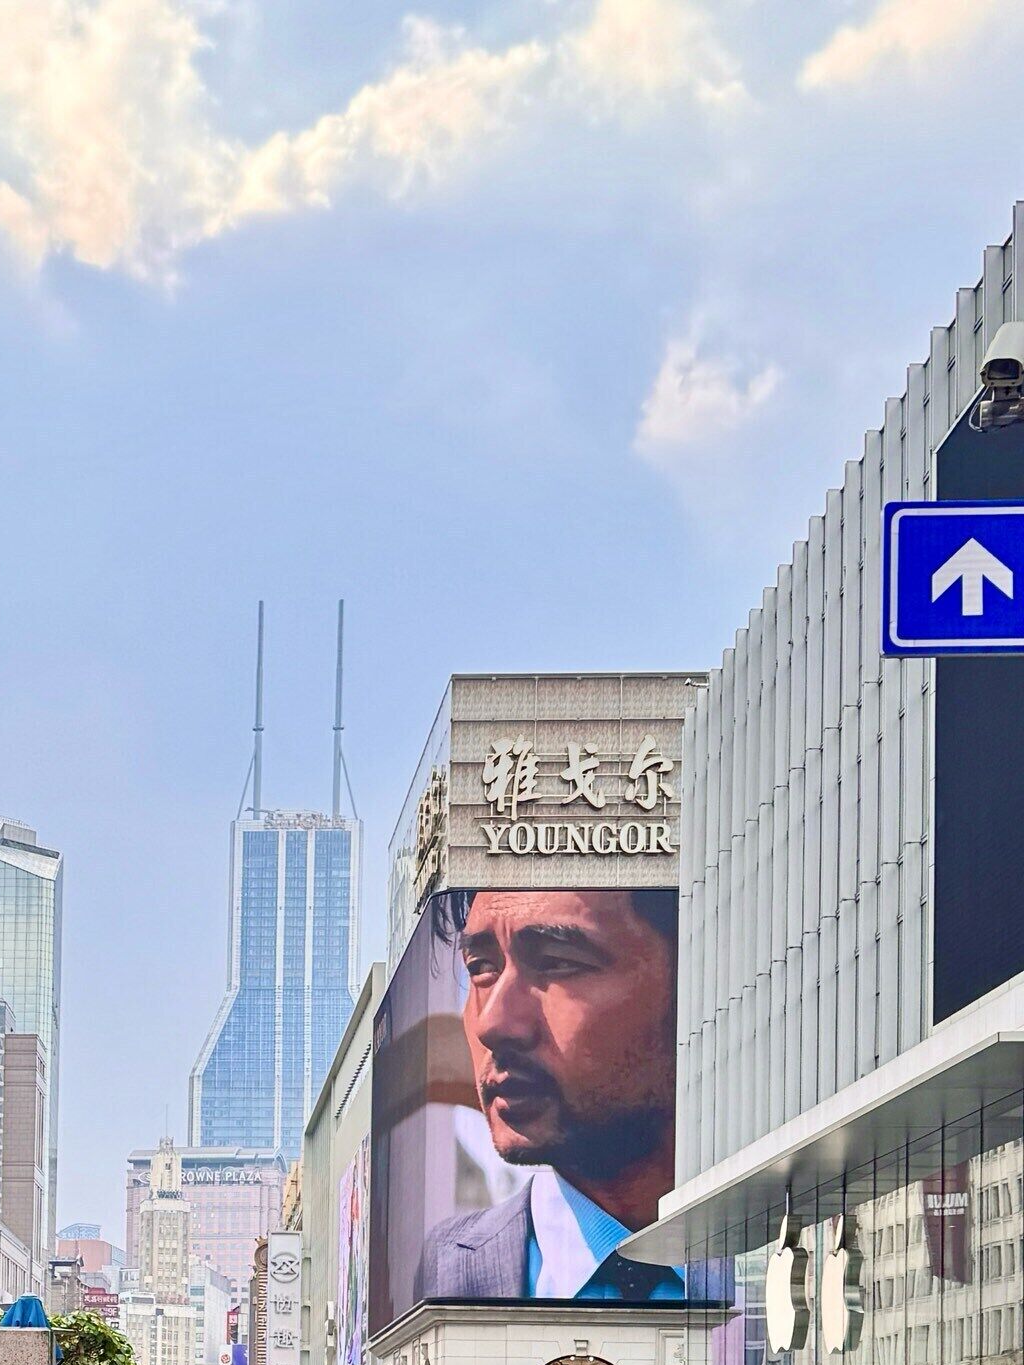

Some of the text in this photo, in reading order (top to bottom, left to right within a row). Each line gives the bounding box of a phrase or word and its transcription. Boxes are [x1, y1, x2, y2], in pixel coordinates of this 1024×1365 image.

[482, 734, 674, 820] 雅戈尔
[481, 822, 676, 855] YOUNGOR
[180, 1170, 262, 1182] ROWNE PLAZA
